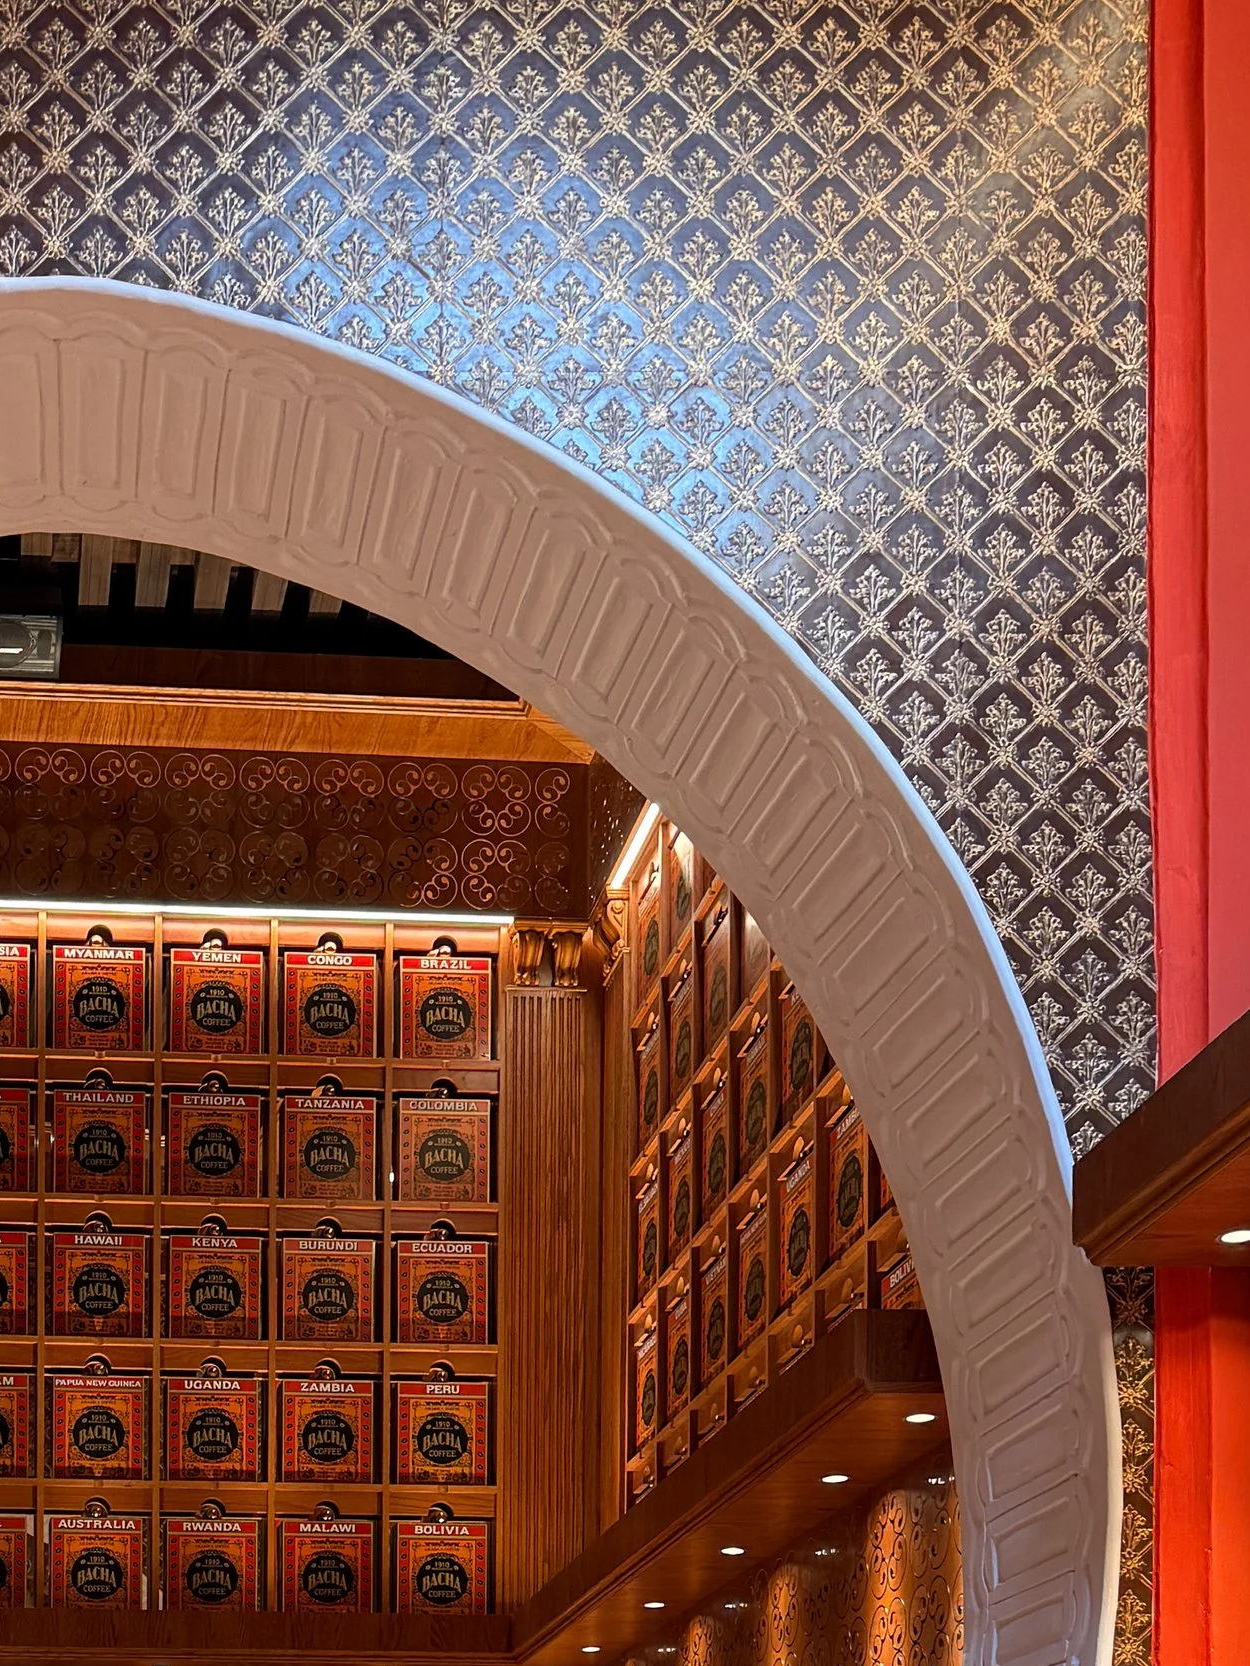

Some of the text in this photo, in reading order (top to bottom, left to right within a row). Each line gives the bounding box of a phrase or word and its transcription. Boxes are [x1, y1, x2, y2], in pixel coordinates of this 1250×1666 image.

[64, 948, 134, 959] MYANMAR
[192, 951, 241, 963] YEMEN
[308, 955, 352, 965] CONGO
[421, 959, 471, 970] BRAZIL
[196, 1000, 235, 1021] BACHA
[425, 1006, 465, 1028] BACHA
[431, 1024, 459, 1032] COFFEE
[63, 1093, 133, 1104] THAILAND
[184, 1096, 245, 1105] ETHIOPIA
[295, 1099, 364, 1109] TANZANIA
[409, 1100, 478, 1111] COLOMBIA
[75, 1235, 122, 1245] HAWAII
[193, 1238, 237, 1247] KENYA
[300, 1241, 357, 1250] BURUNDI
[413, 1243, 471, 1253] ECUADOR
[86, 1379, 107, 1387] NEW
[185, 1380, 240, 1390] UGANDA
[301, 1383, 354, 1392] ZAMBIA
[427, 1385, 459, 1394] PERU
[79, 1424, 118, 1446] BACHA
[58, 1519, 135, 1530] AUSTRALIA
[183, 1523, 241, 1531] RWANDA
[300, 1524, 355, 1534] MALAWI
[415, 1526, 469, 1534] BOLIVIA
[422, 1572, 461, 1593] BACHA
